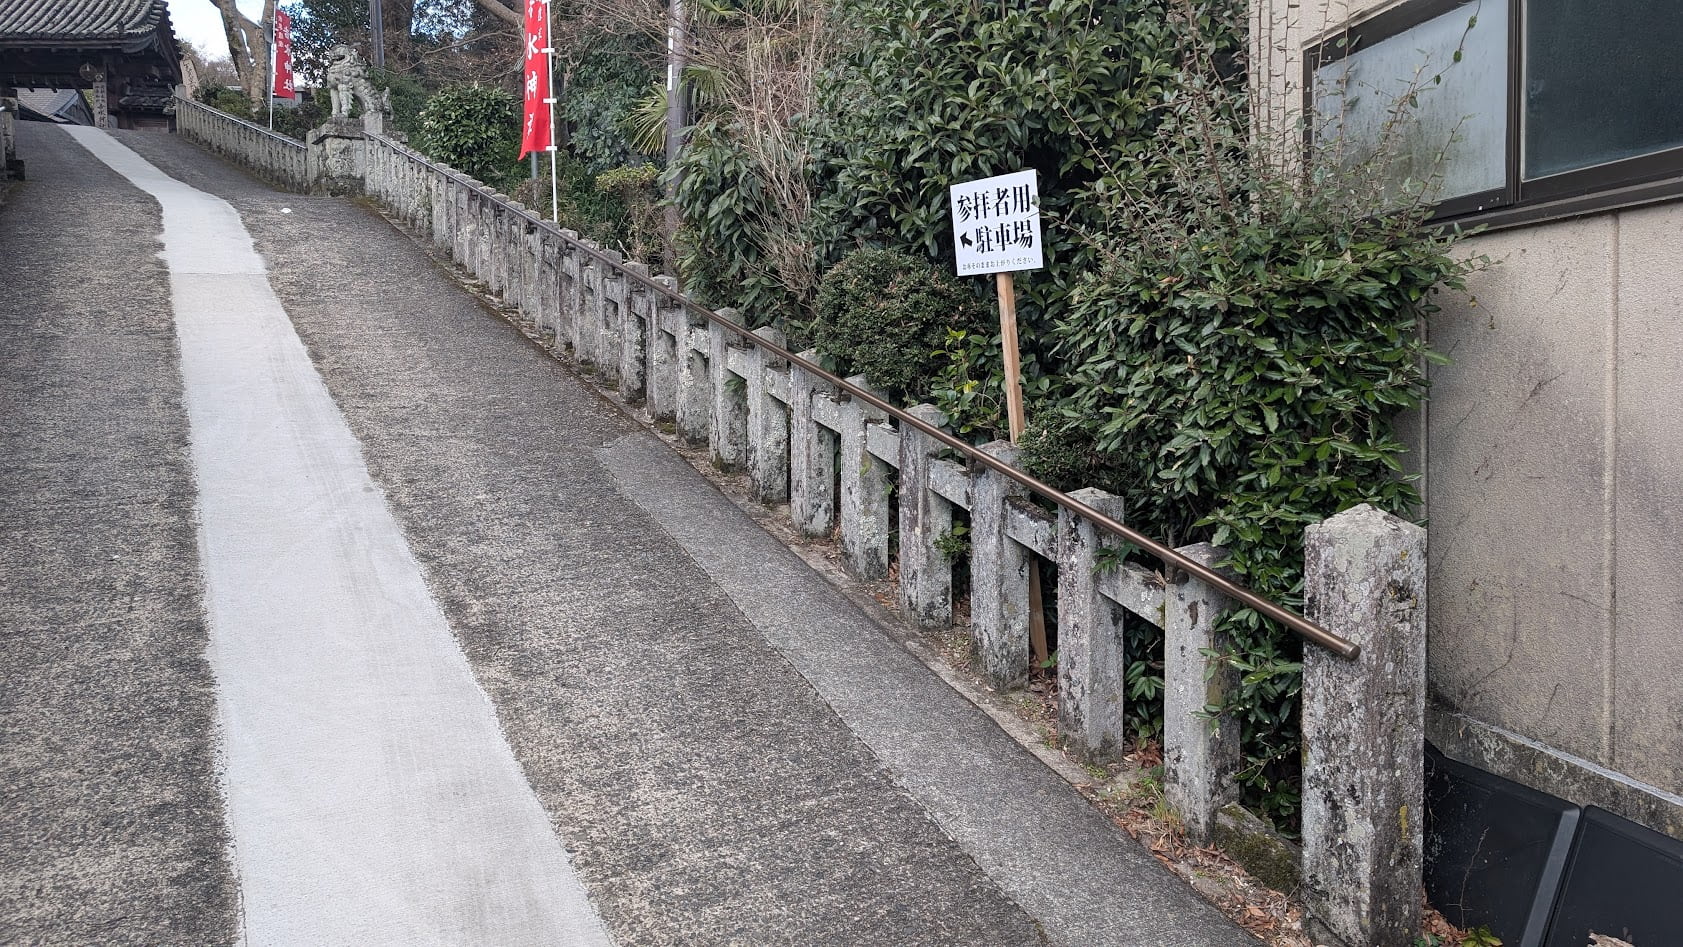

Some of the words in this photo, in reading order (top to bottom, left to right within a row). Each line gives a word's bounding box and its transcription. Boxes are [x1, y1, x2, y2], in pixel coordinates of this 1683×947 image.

[957, 184, 1030, 223] 参拝者用
[975, 220, 1033, 254] 駐車場
